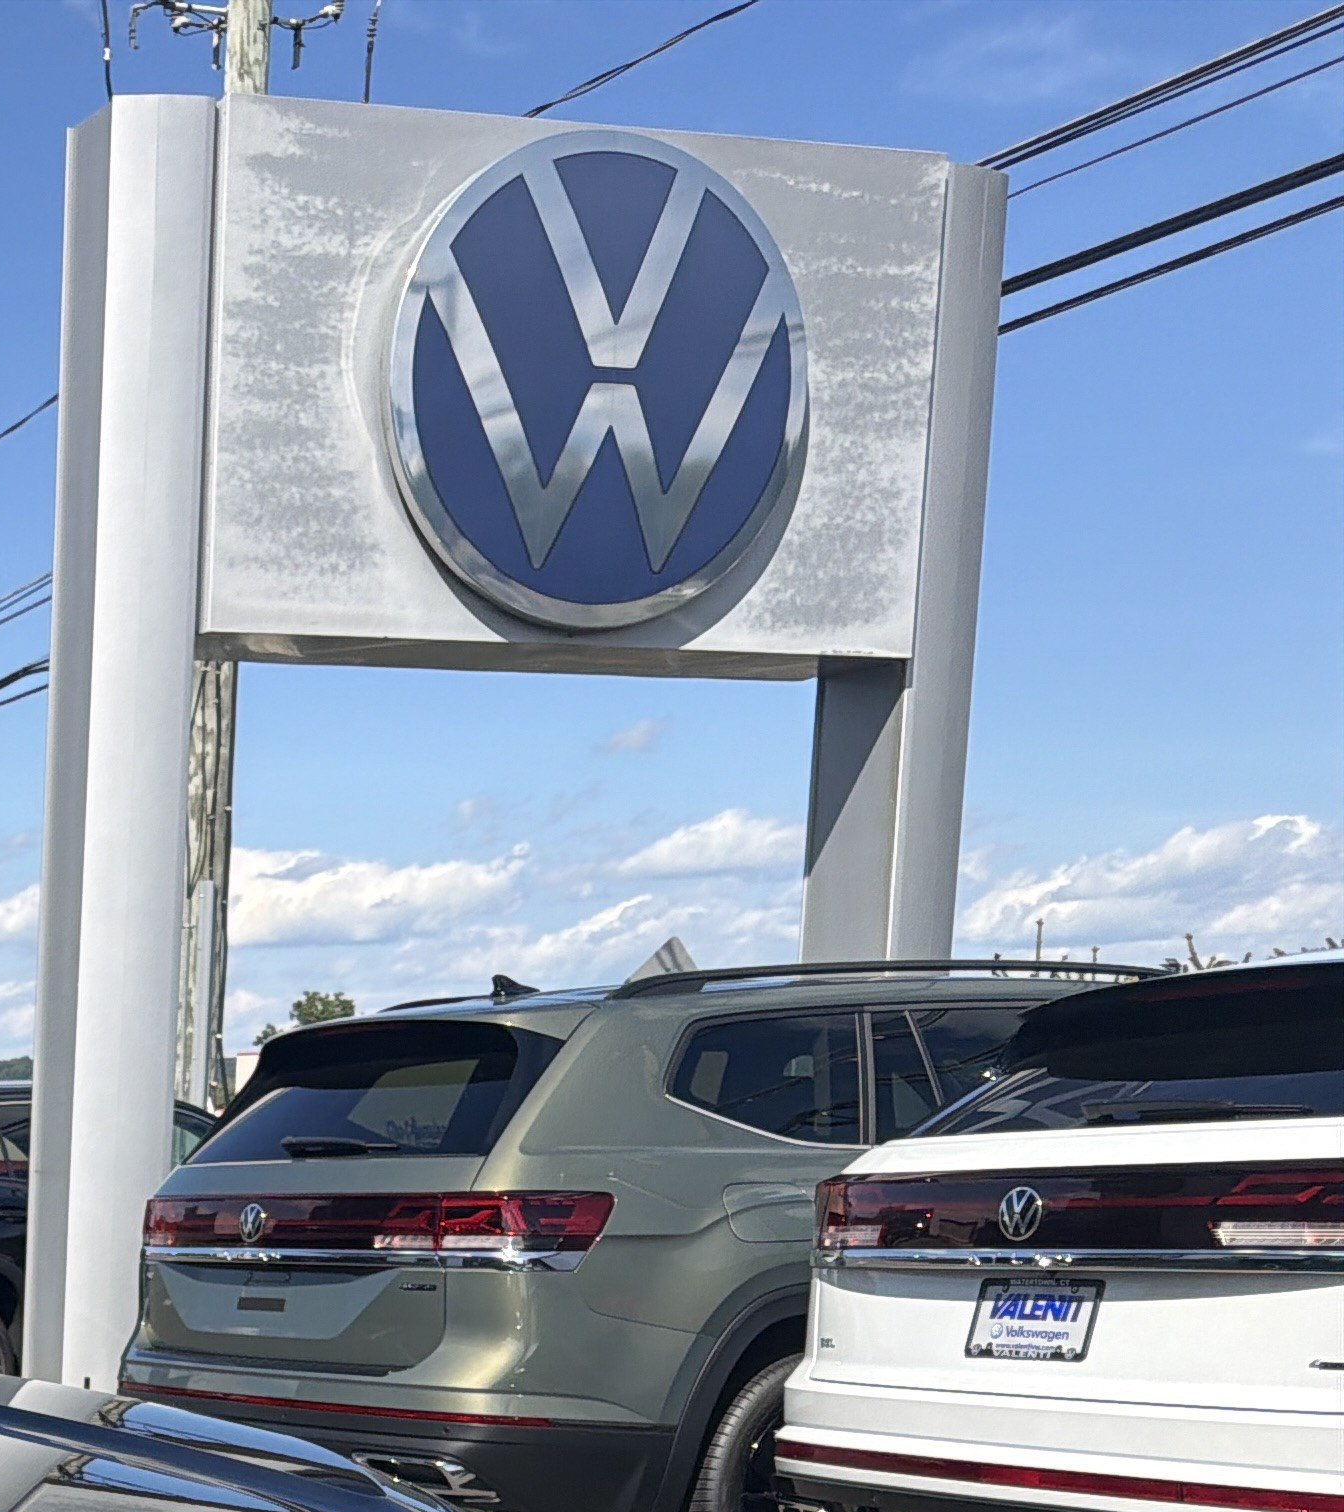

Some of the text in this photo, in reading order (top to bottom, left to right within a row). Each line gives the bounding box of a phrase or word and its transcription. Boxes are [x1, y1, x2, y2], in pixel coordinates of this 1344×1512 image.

[989, 1293, 1086, 1323] VALENTI
[1006, 1325, 1070, 1342] Volkswagen
[993, 1349, 1052, 1359] VALENTI
